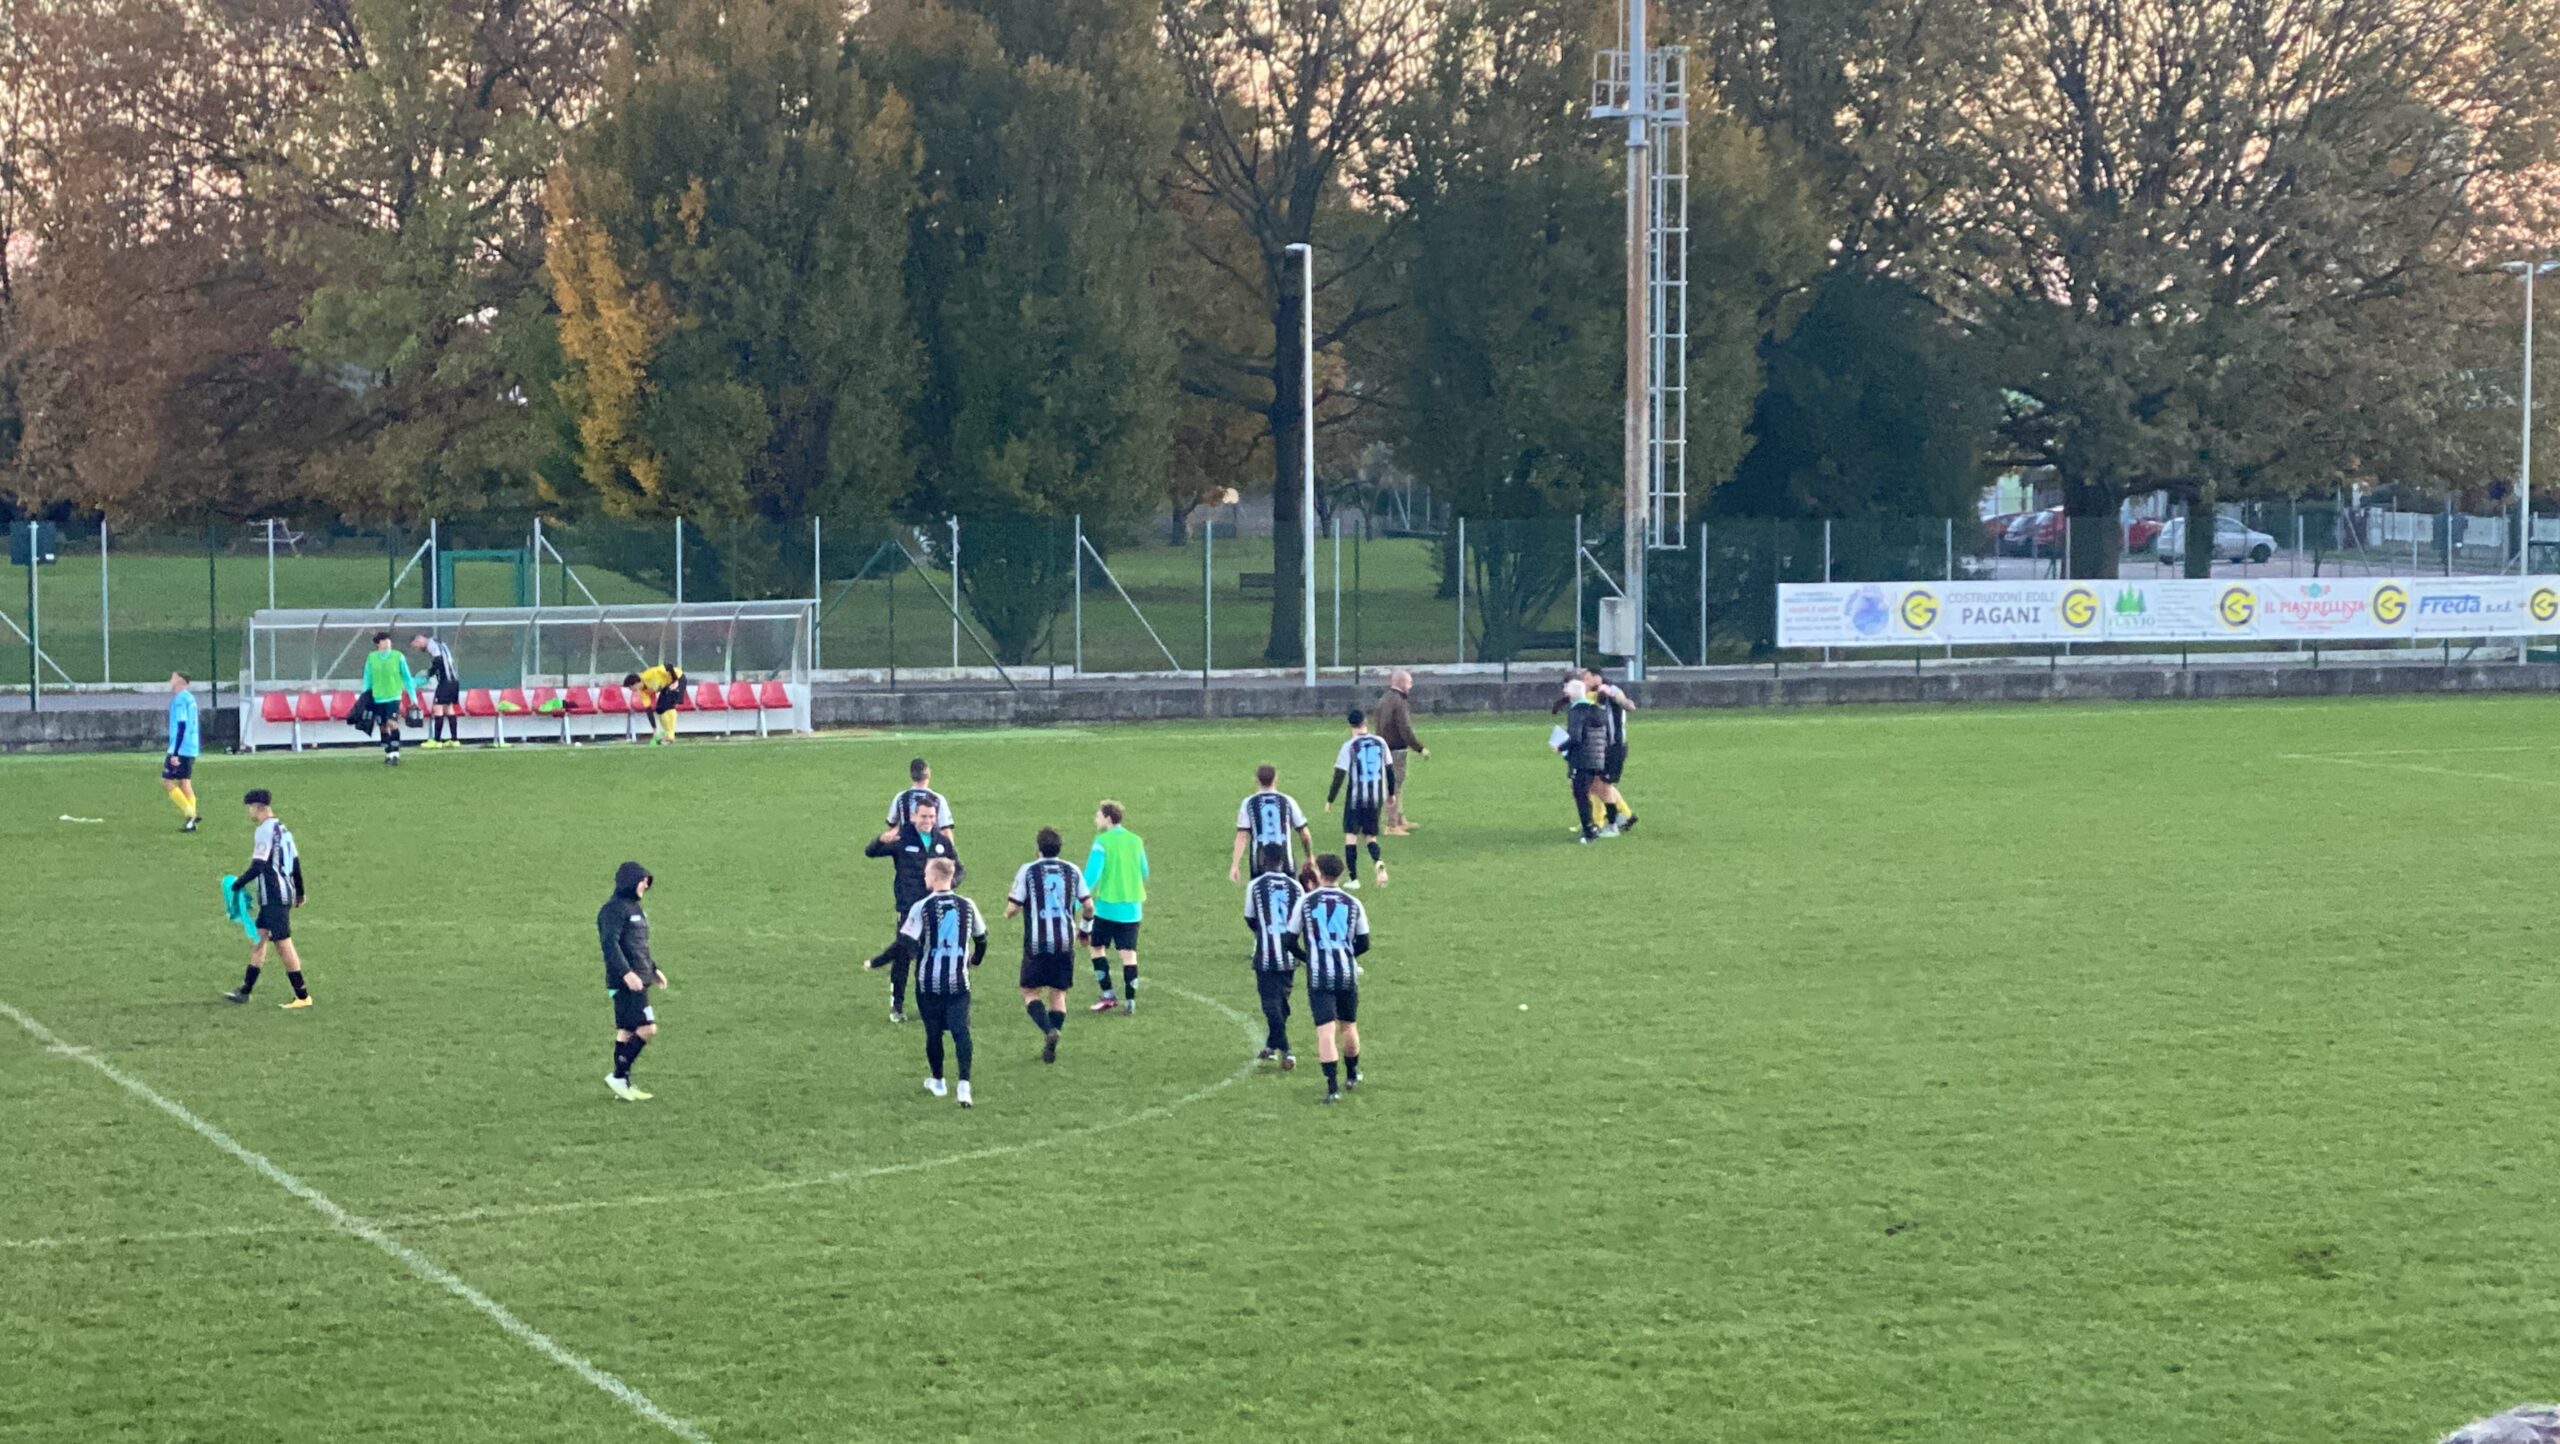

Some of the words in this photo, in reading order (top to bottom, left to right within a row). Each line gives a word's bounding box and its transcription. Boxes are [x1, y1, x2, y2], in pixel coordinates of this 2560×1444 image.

[1948, 592, 2022, 603] COSTRUZIONI
[2026, 591, 2055, 602] EDILI
[2418, 594, 2481, 614] Freda
[1961, 606, 2041, 624] PAGANI
[2264, 601, 2276, 614] IL
[2280, 600, 2366, 619] PIASTRELLISTA
[1312, 902, 1350, 941] 14
